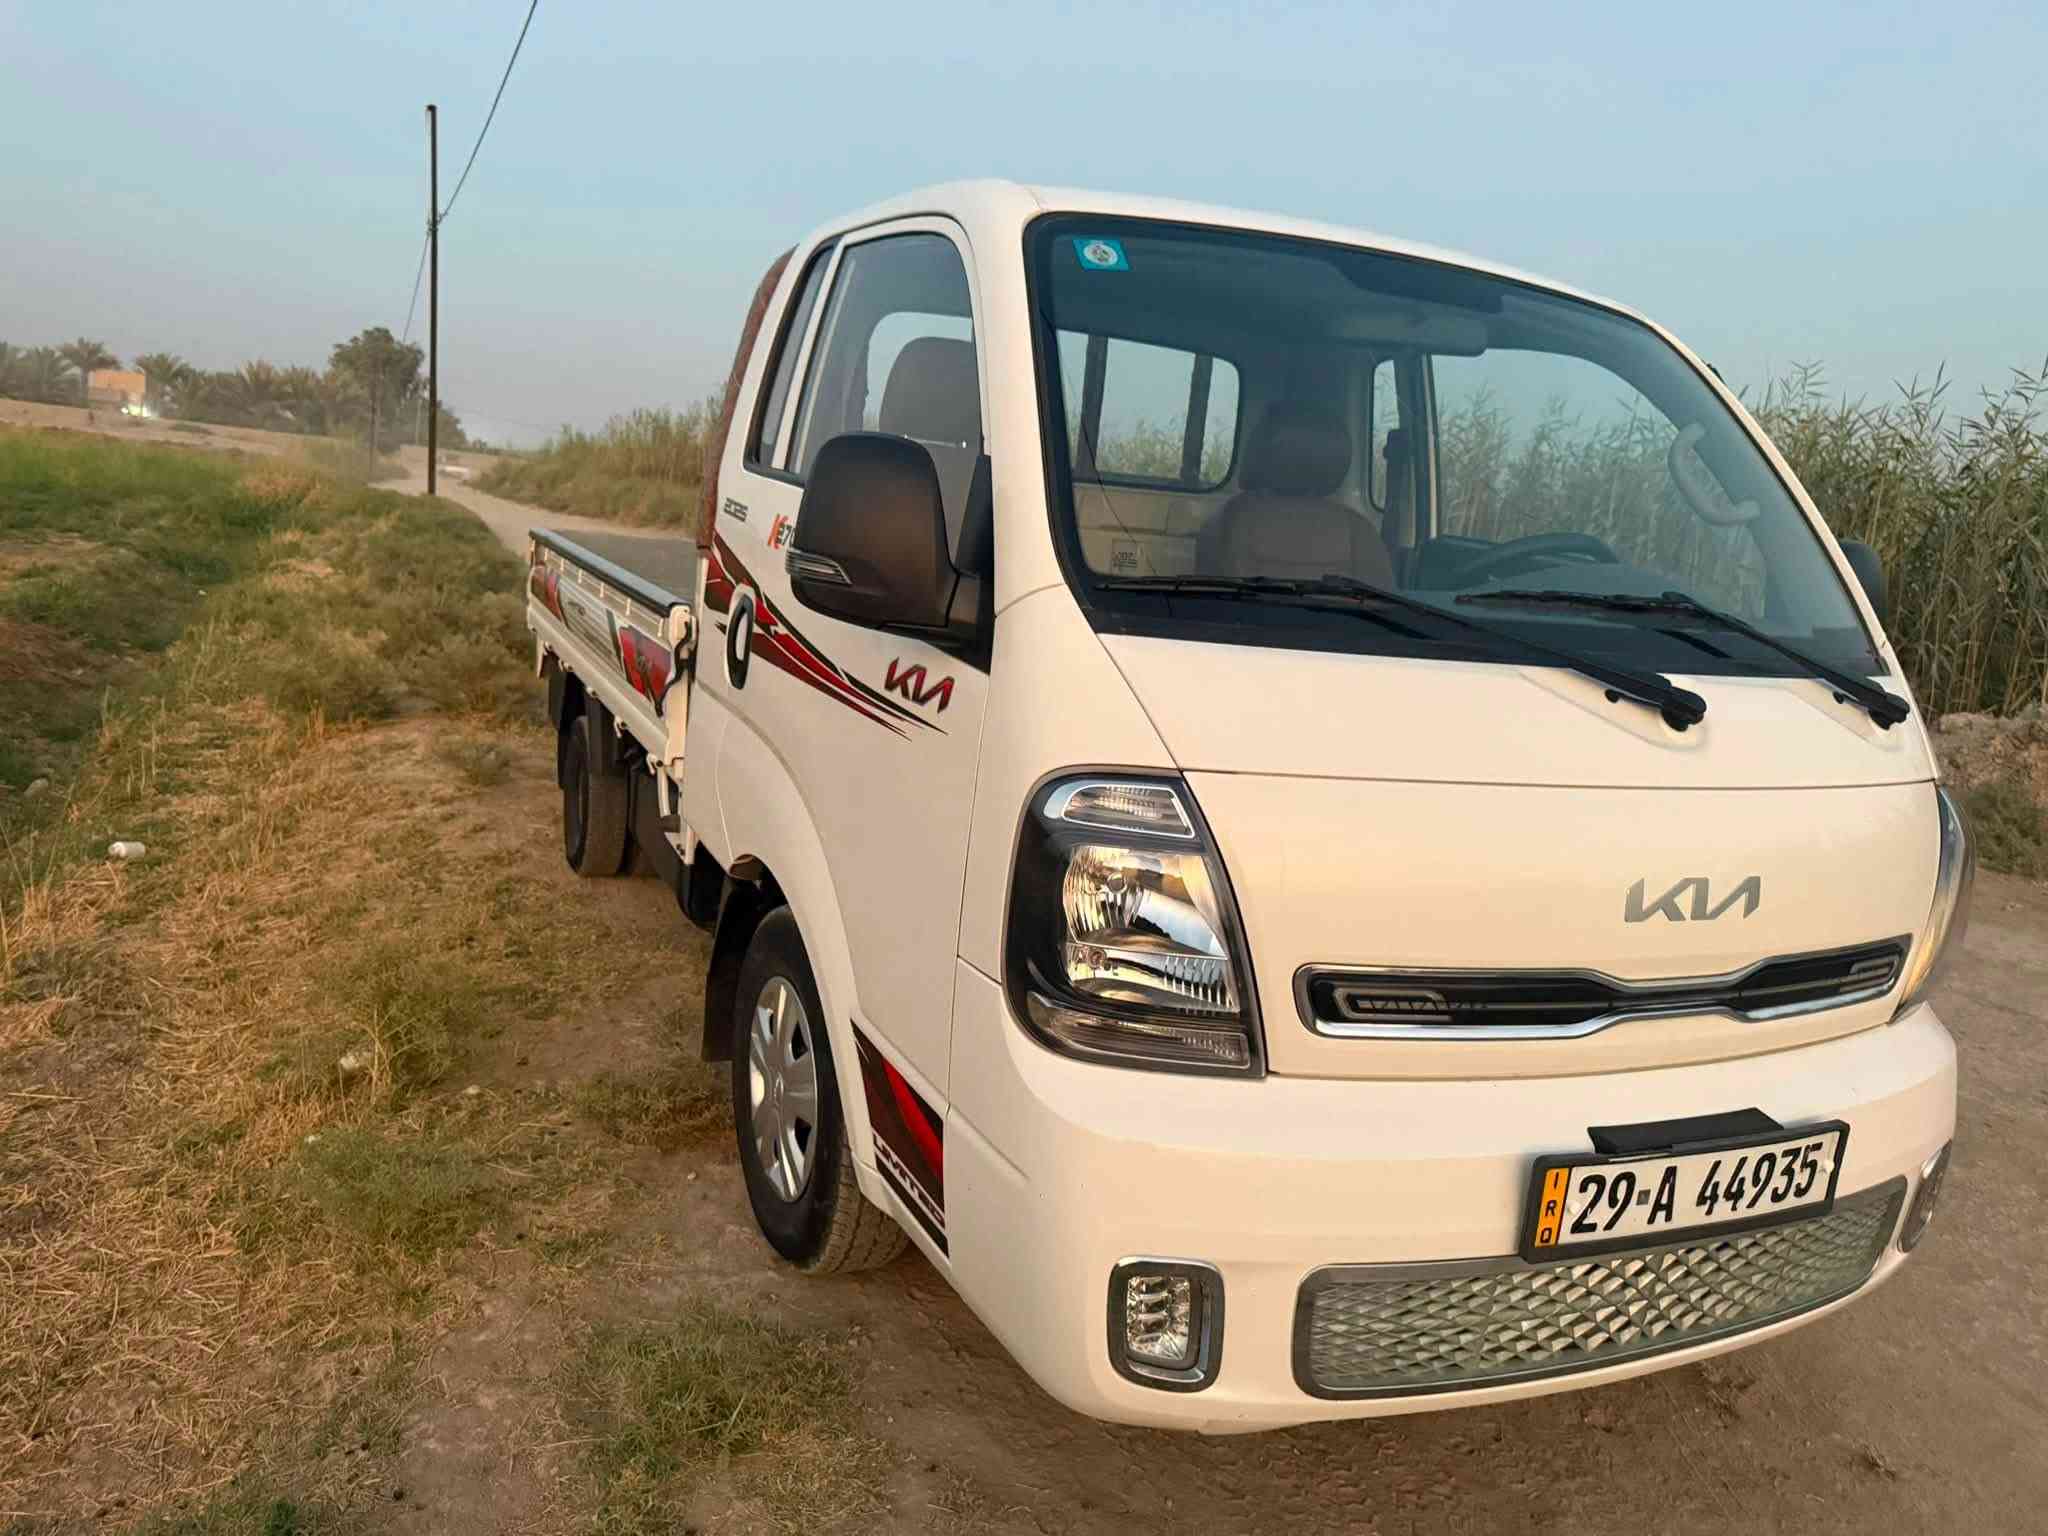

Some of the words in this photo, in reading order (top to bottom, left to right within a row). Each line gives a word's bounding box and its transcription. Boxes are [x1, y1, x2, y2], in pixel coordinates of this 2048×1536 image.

[885, 656, 955, 714] KIA
[1624, 876, 1761, 922] KIA
[1696, 1142, 1823, 1216] 44935
